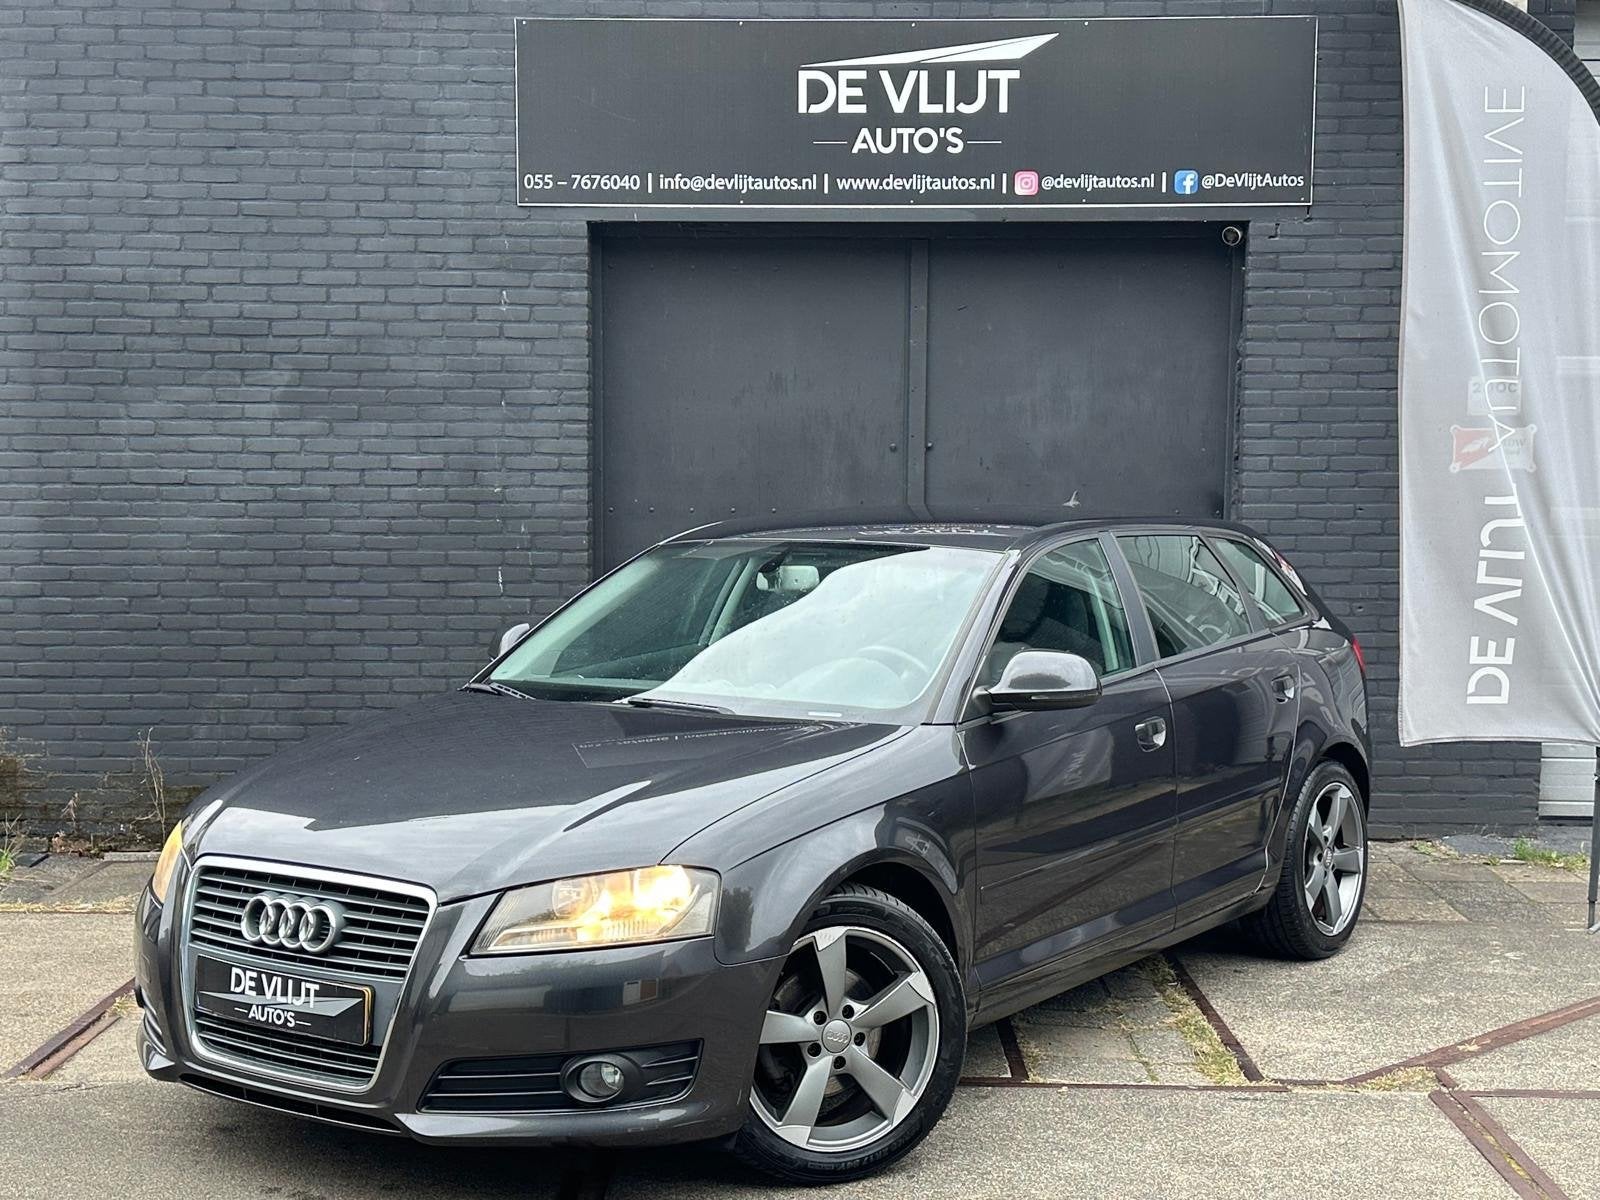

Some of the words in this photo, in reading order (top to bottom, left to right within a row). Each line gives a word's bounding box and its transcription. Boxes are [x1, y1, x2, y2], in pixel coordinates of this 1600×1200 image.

[797, 69, 868, 114] DE
[878, 69, 1021, 115] VLIJT
[851, 126, 964, 155] AUTO'S
[523, 174, 554, 190] 055
[571, 174, 641, 191] 7676040
[659, 173, 817, 194] info@devlijtautos.nl
[836, 173, 996, 194] www.devlijtautos.nl
[1041, 173, 1155, 192] @devlijtautos.nl
[1202, 172, 1305, 191] @DeVlijtAutos
[230, 967, 257, 996] DE
[261, 974, 320, 1008] VLIJT
[249, 1006, 296, 1027] AUTO'S
